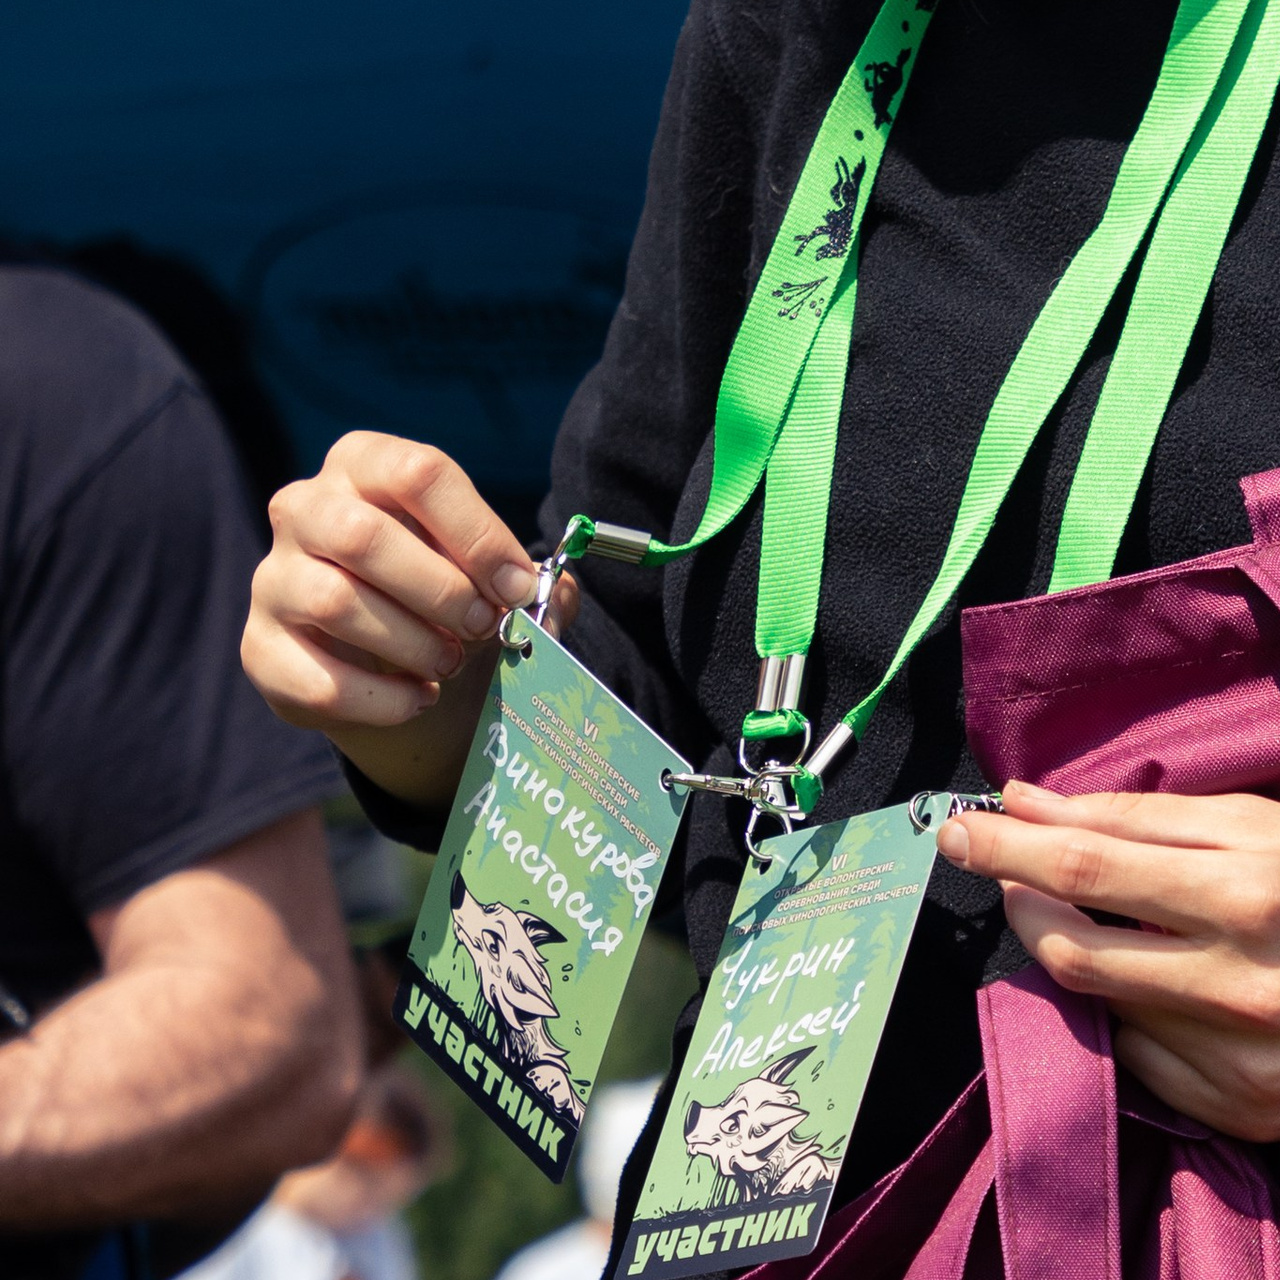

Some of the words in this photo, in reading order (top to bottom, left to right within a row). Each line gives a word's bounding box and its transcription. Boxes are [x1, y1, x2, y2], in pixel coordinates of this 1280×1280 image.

[531, 694, 576, 742] ОТКРЫТЫЕ
[575, 734, 641, 803] ВОЛОНТЕРСКИЕ
[534, 716, 600, 783] СОРЕВНОВАНИЯ
[599, 777, 629, 810] СРЕДИ
[583, 717, 599, 743] VI
[494, 696, 545, 749] ПОИСКОВЫХ
[543, 743, 619, 821] КИНОЛОГИЧЕСКИХ
[618, 813, 662, 860] РАСЧЕТОВ
[483, 721, 656, 919] Винокурова
[773, 880, 823, 901] ОТКРЫТЫЕ
[823, 861, 896, 888] ВОЛОНТЕРСКИЕ
[776, 887, 851, 913] СОРЕВНОВАНИЯ
[849, 878, 882, 896] СРЕДИ
[831, 854, 849, 872] VI
[732, 917, 789, 939] ПОИСКОВЫХ
[787, 895, 872, 925] КИНОЛОГИЧЕСКИХ
[872, 883, 920, 904] РАСЧЕТОВ
[692, 981, 866, 1078] Алексей
